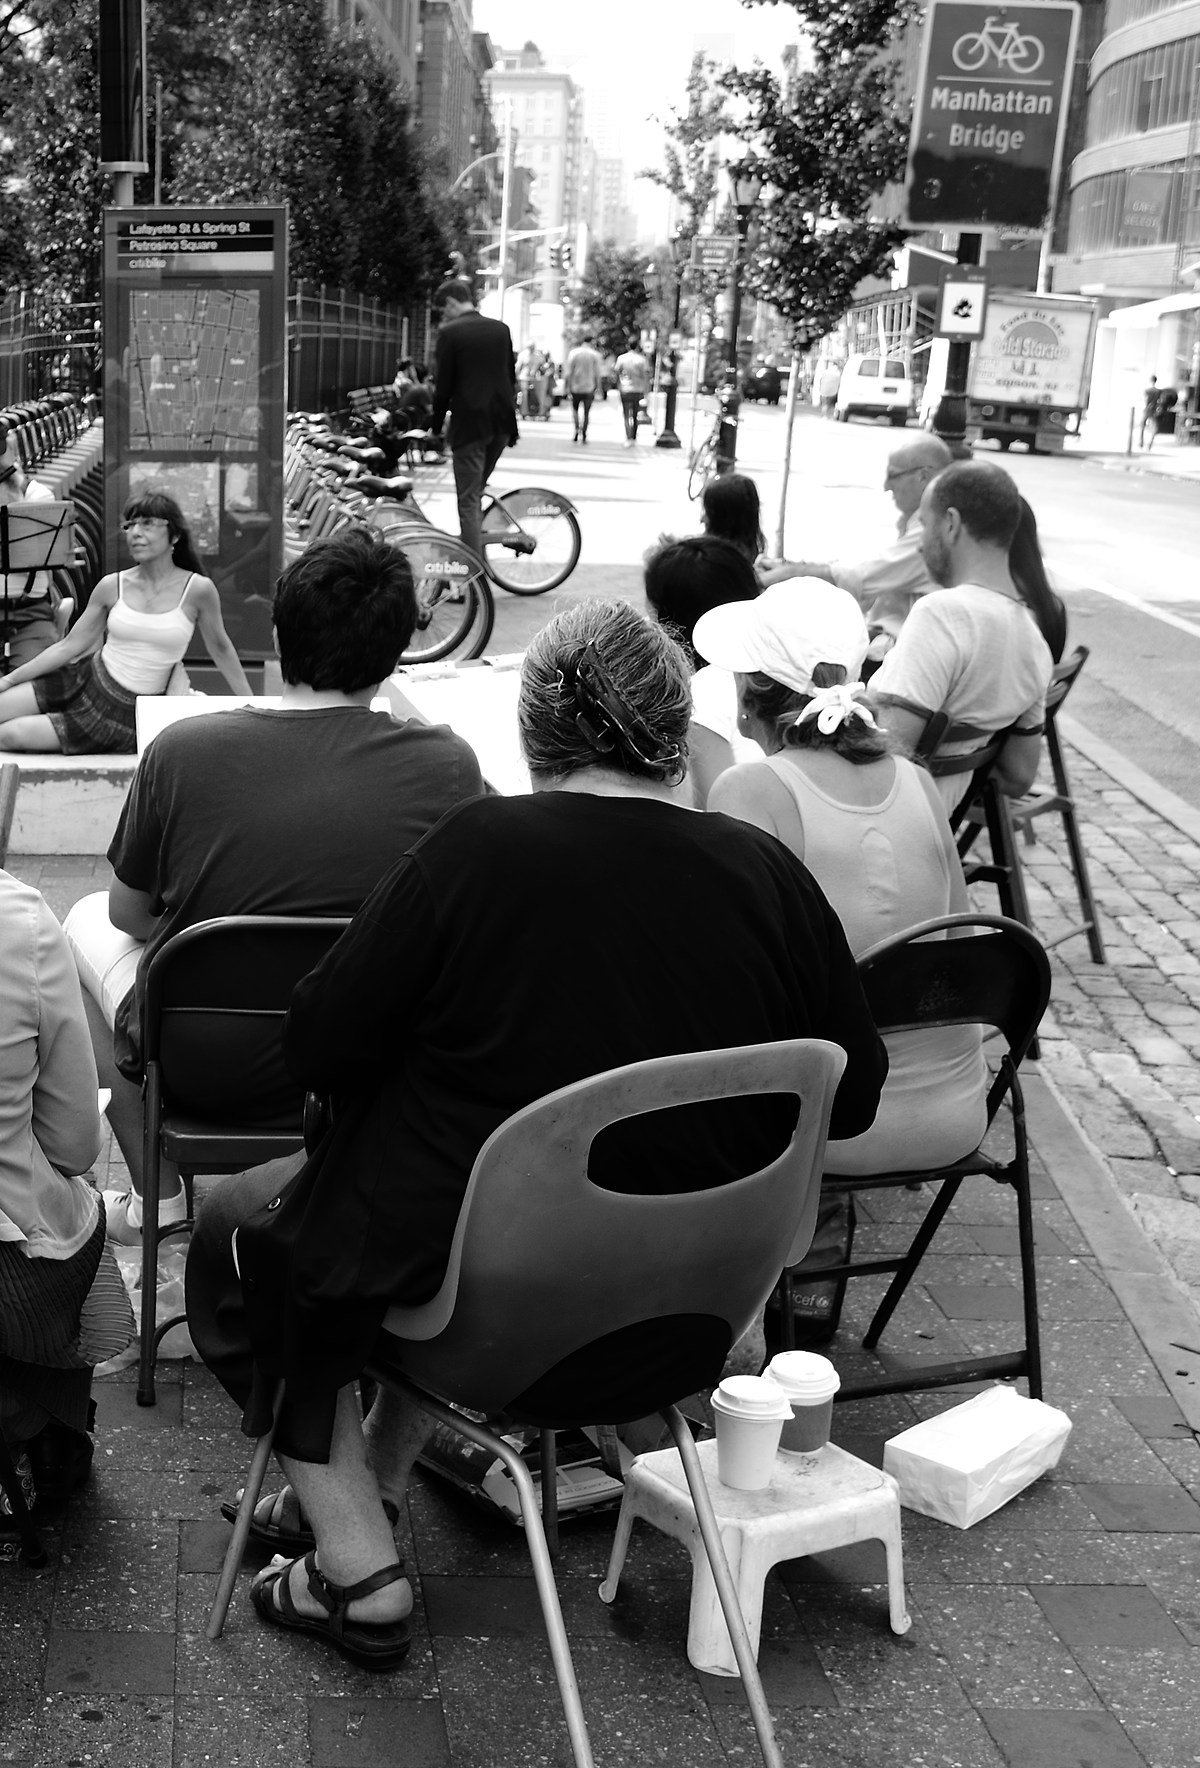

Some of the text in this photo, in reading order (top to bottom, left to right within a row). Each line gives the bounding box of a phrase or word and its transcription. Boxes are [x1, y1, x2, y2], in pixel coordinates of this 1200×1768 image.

[930, 86, 1053, 115] Manhattan
[949, 122, 1025, 154] Bridge
[129, 221, 251, 236] Lafayette St & Spring St
[129, 239, 218, 251] Petrosino Square
